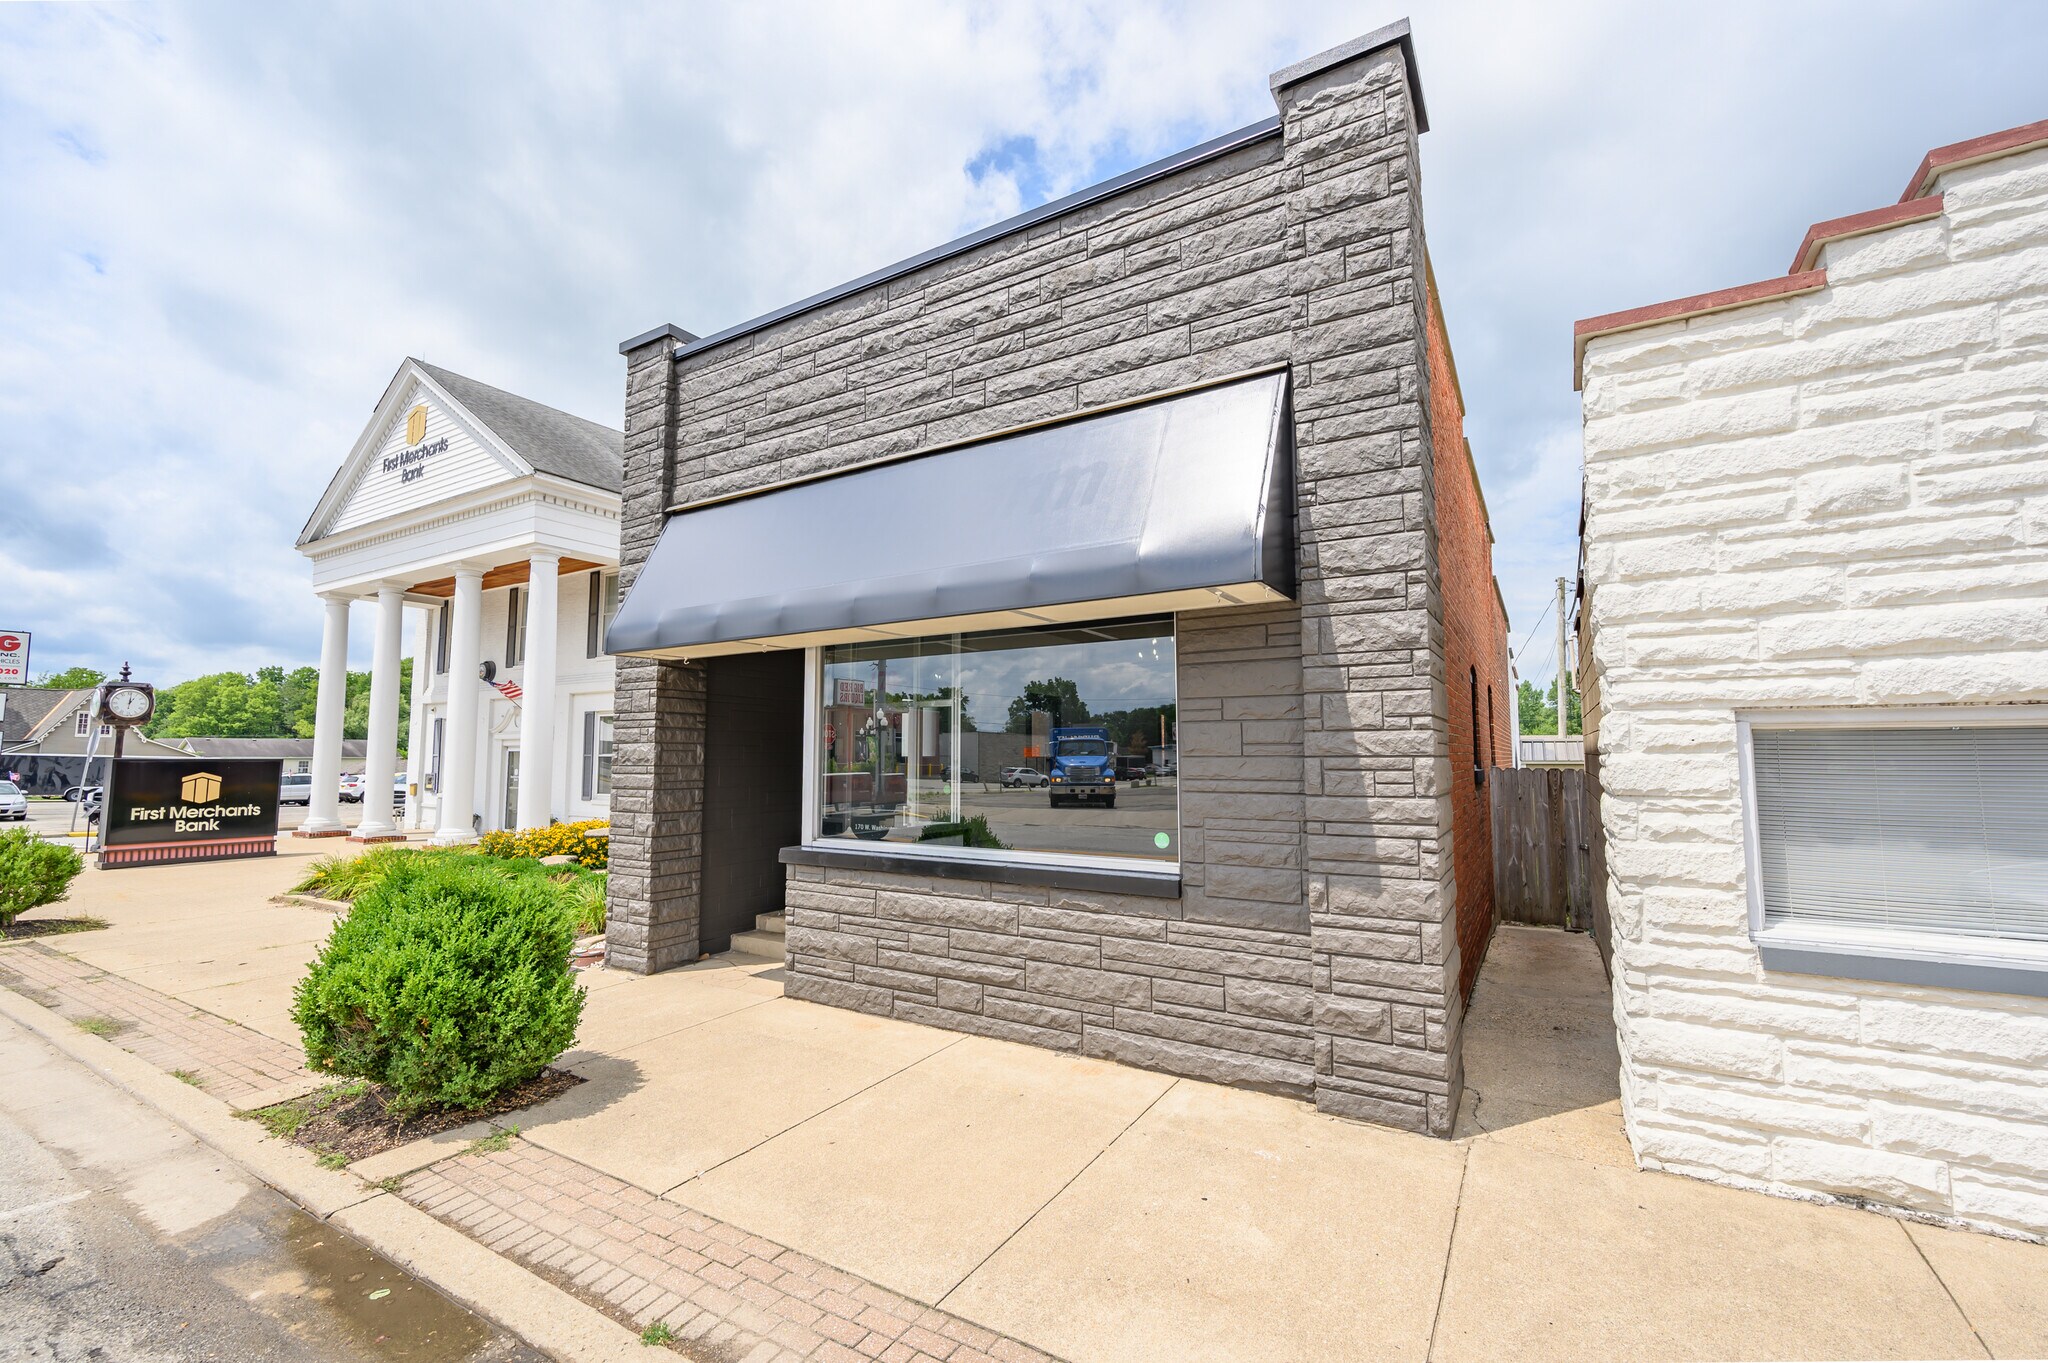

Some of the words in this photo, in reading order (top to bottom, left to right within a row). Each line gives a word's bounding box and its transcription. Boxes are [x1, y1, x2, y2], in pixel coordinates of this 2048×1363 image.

[383, 454, 399, 473] First
[399, 437, 449, 467] Merchants
[401, 463, 425, 484] Bank
[131, 806, 166, 820] First
[169, 803, 261, 819] Merchants
[175, 818, 220, 833] Bank
